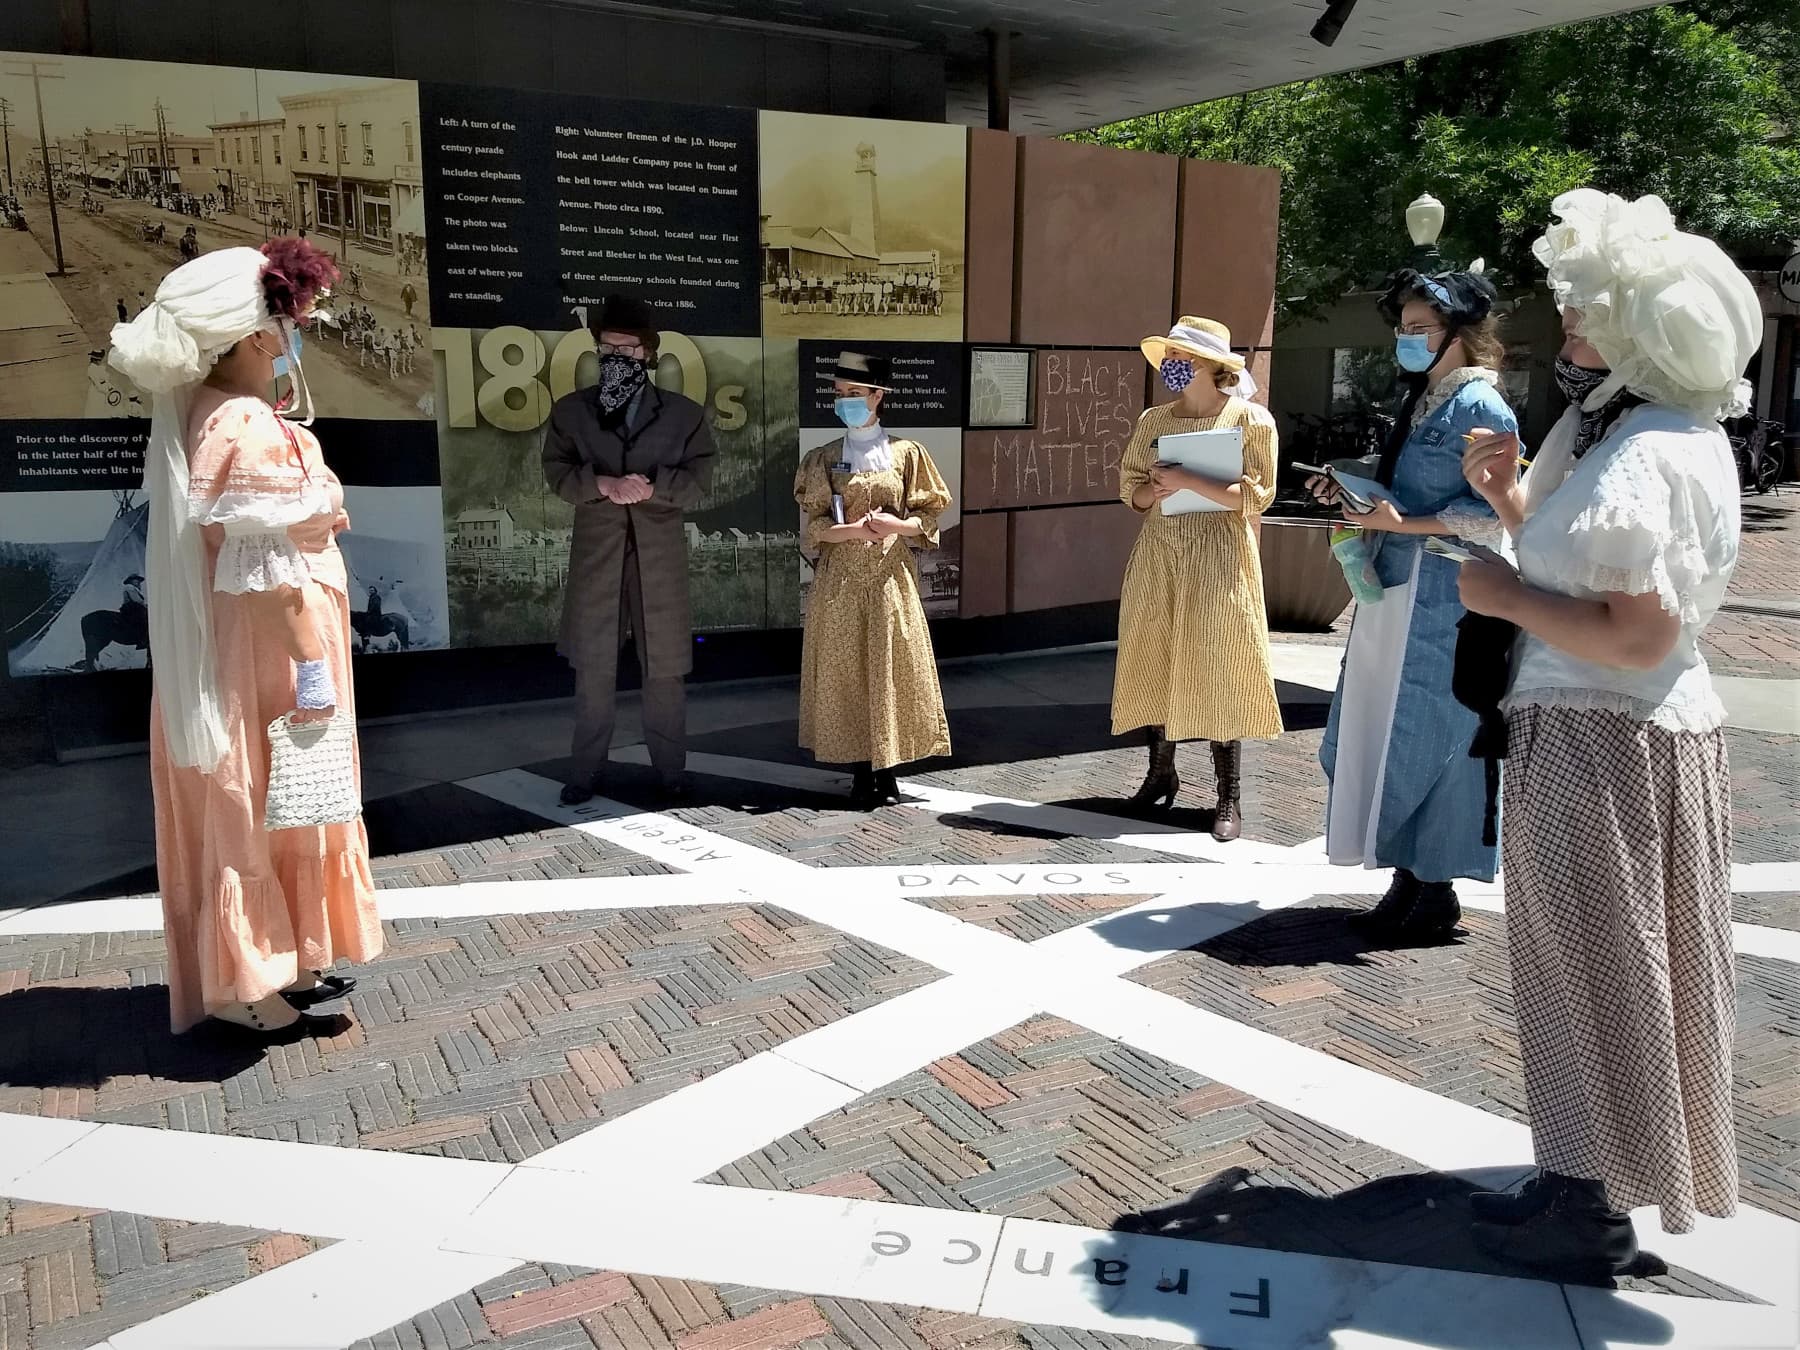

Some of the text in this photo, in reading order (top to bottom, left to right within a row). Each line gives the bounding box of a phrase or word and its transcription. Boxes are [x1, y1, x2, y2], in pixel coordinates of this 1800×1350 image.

[502, 122, 516, 130] the
[555, 126, 579, 136] Right:
[584, 128, 622, 138] Volunteer
[627, 132, 657, 141] firemen
[674, 136, 687, 144] the
[691, 137, 704, 146] J.D.
[709, 139, 736, 149] Hooper
[441, 145, 504, 154] century parade
[556, 151, 578, 159] Hook
[582, 153, 597, 161] and
[601, 154, 629, 163] Ladder
[633, 156, 669, 168] Company
[707, 162, 725, 171] front
[481, 170, 521, 180] elephants
[557, 175, 570, 183] the
[575, 176, 590, 184] bell
[620, 180, 644, 188] which
[667, 183, 695, 192] located
[712, 187, 737, 195] Durant
[457, 193, 488, 203] Cooper
[491, 195, 525, 204] Avenue.
[559, 200, 664, 214] Avenue. Photo circa 1890.
[463, 219, 487, 228] photo
[560, 224, 587, 232] Below:
[594, 226, 624, 234] Lincoln
[630, 228, 659, 237] School,
[665, 230, 693, 239] located
[446, 242, 470, 250] taken
[491, 244, 518, 253] blocks
[561, 248, 584, 256] Street
[606, 250, 636, 259] Bleeker
[688, 255, 703, 264] End,
[479, 268, 505, 276] where
[600, 274, 643, 284] elementary
[647, 276, 676, 284] schools
[680, 278, 711, 286] founded
[715, 280, 739, 289] during
[465, 292, 503, 302] standing.
[578, 297, 599, 305] silver
[655, 299, 673, 307] circa
[1047, 354, 1134, 407] BLACK
[1042, 400, 1132, 438] LIVES
[59, 435, 76, 443] the
[80, 435, 128, 444] discovery
[132, 434, 142, 442] of
[53, 451, 80, 459] latter
[121, 450, 137, 458] the
[992, 434, 1121, 500] MATTER
[897, 871, 1131, 887] DAVOS
[871, 1230, 1270, 1318] France
